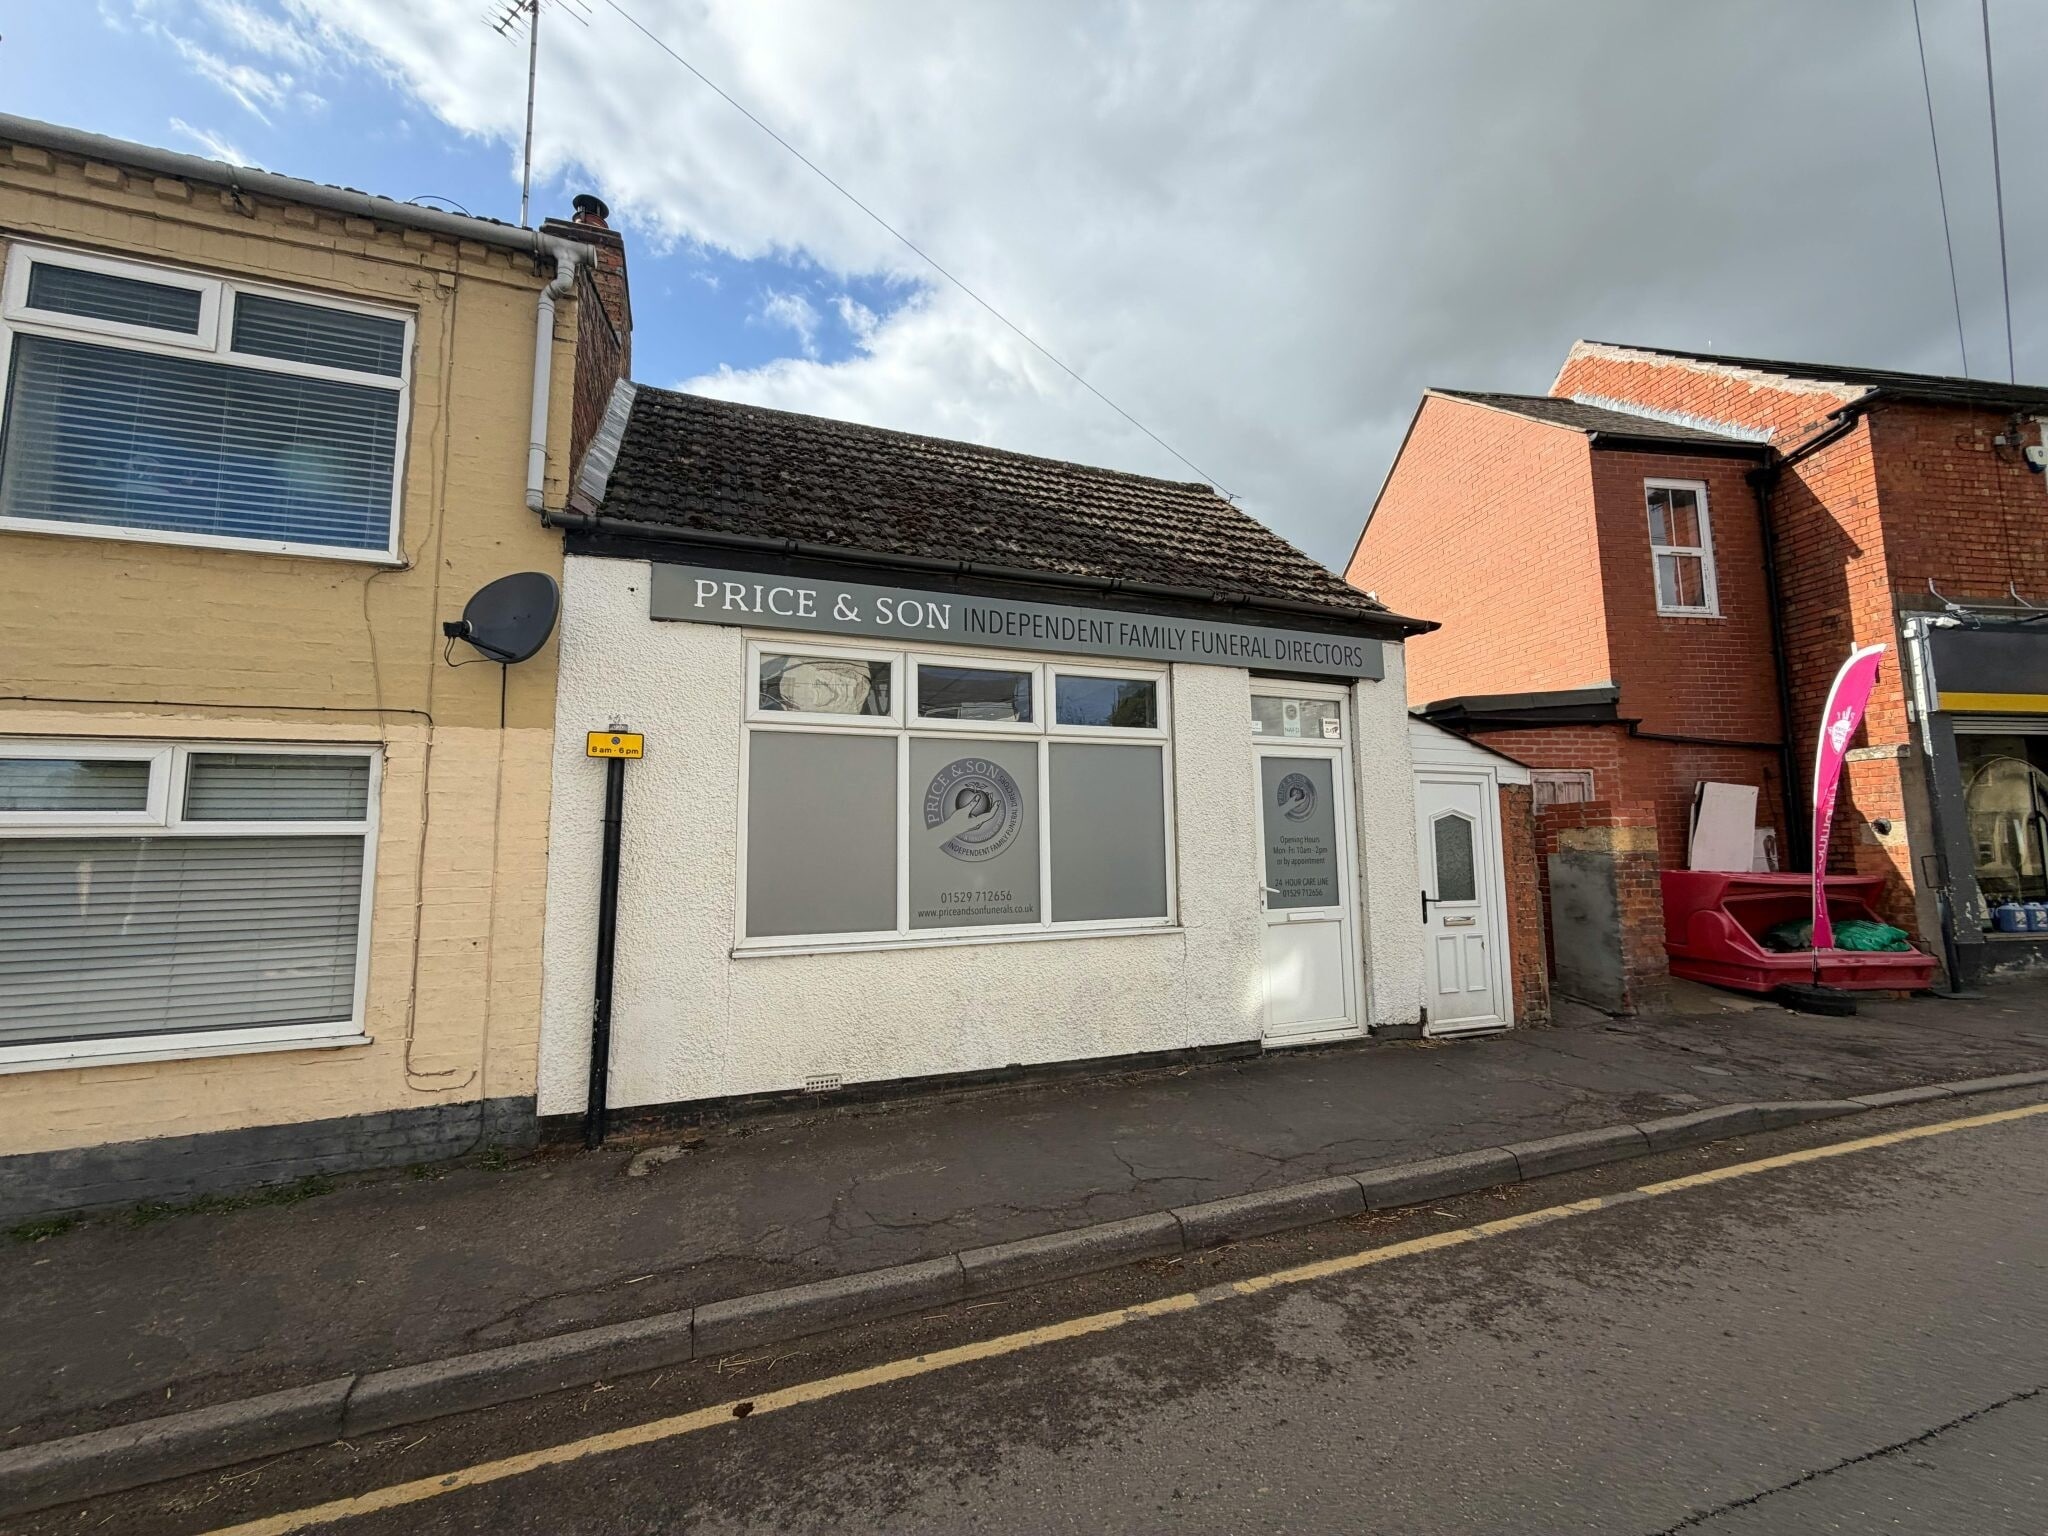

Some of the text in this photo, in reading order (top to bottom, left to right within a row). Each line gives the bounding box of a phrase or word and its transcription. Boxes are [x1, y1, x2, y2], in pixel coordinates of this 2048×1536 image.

[694, 579, 1363, 668] PRICE & SON INDEPENDENT FAMILY FUNERAL DIRECTORS
[927, 760, 999, 823] PRICE & SON
[947, 841, 990, 857] INDEPENDENT
[990, 834, 1009, 852] FAMILY
[1006, 809, 1018, 836] FUNERAL
[1280, 835, 1320, 845] Opening Hours
[1296, 846, 1311, 854] 10am
[1315, 845, 1328, 855] 2pm
[1283, 856, 1290, 867] by
[1290, 857, 1325, 867] appointment
[1274, 877, 1329, 887] 24 HOUR CARE LINE
[941, 891, 1012, 903] 01529 712656
[1282, 888, 1301, 898] 01529
[918, 904, 1034, 919] www.priceandsonfunerals.co.uk
